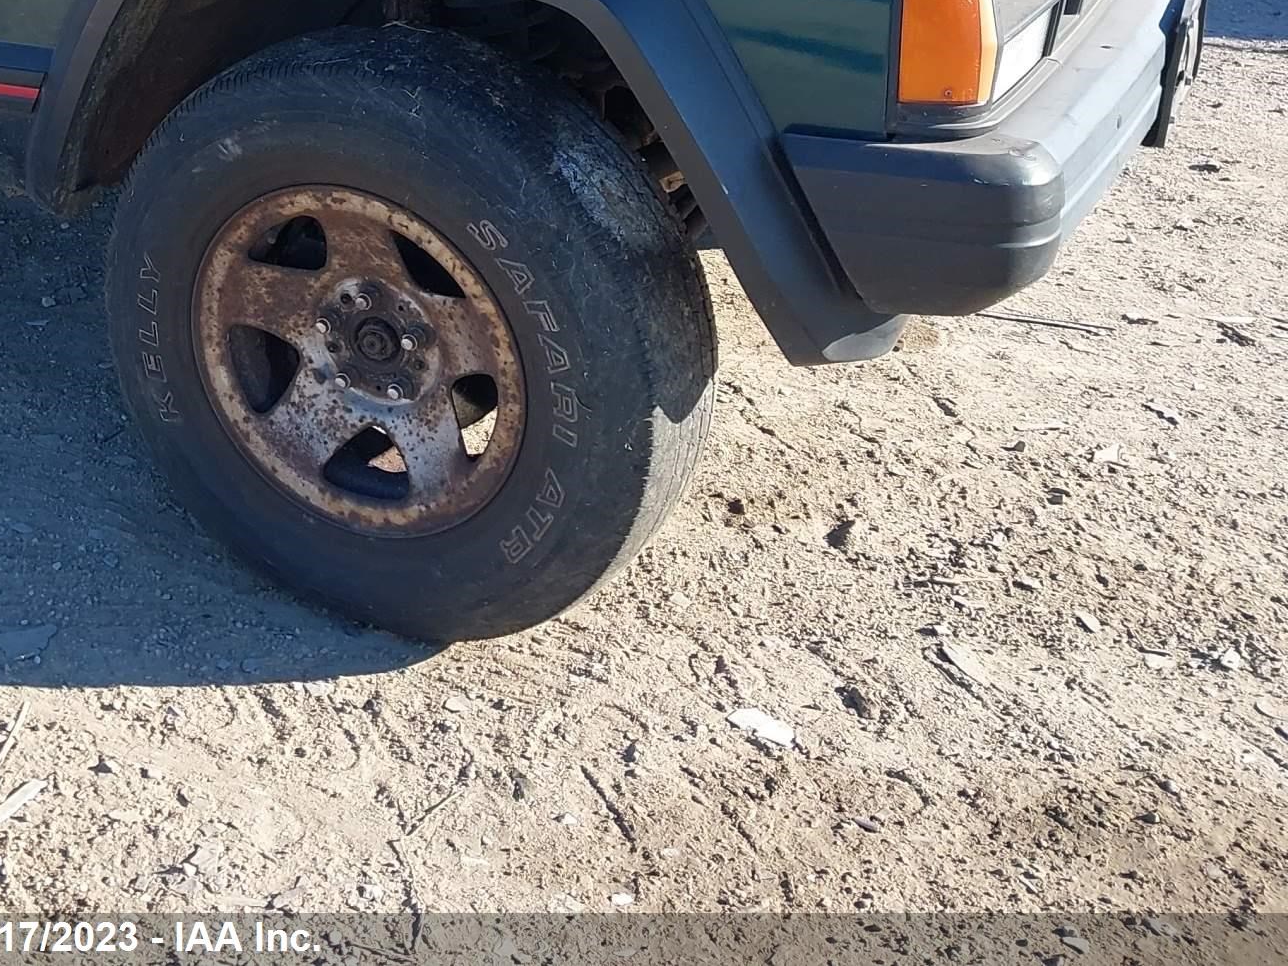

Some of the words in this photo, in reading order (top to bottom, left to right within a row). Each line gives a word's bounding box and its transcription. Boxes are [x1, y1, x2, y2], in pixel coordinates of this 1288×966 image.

[136, 250, 184, 423] KELLY
[466, 219, 580, 449] SAFARI
[499, 467, 568, 565] ATR
